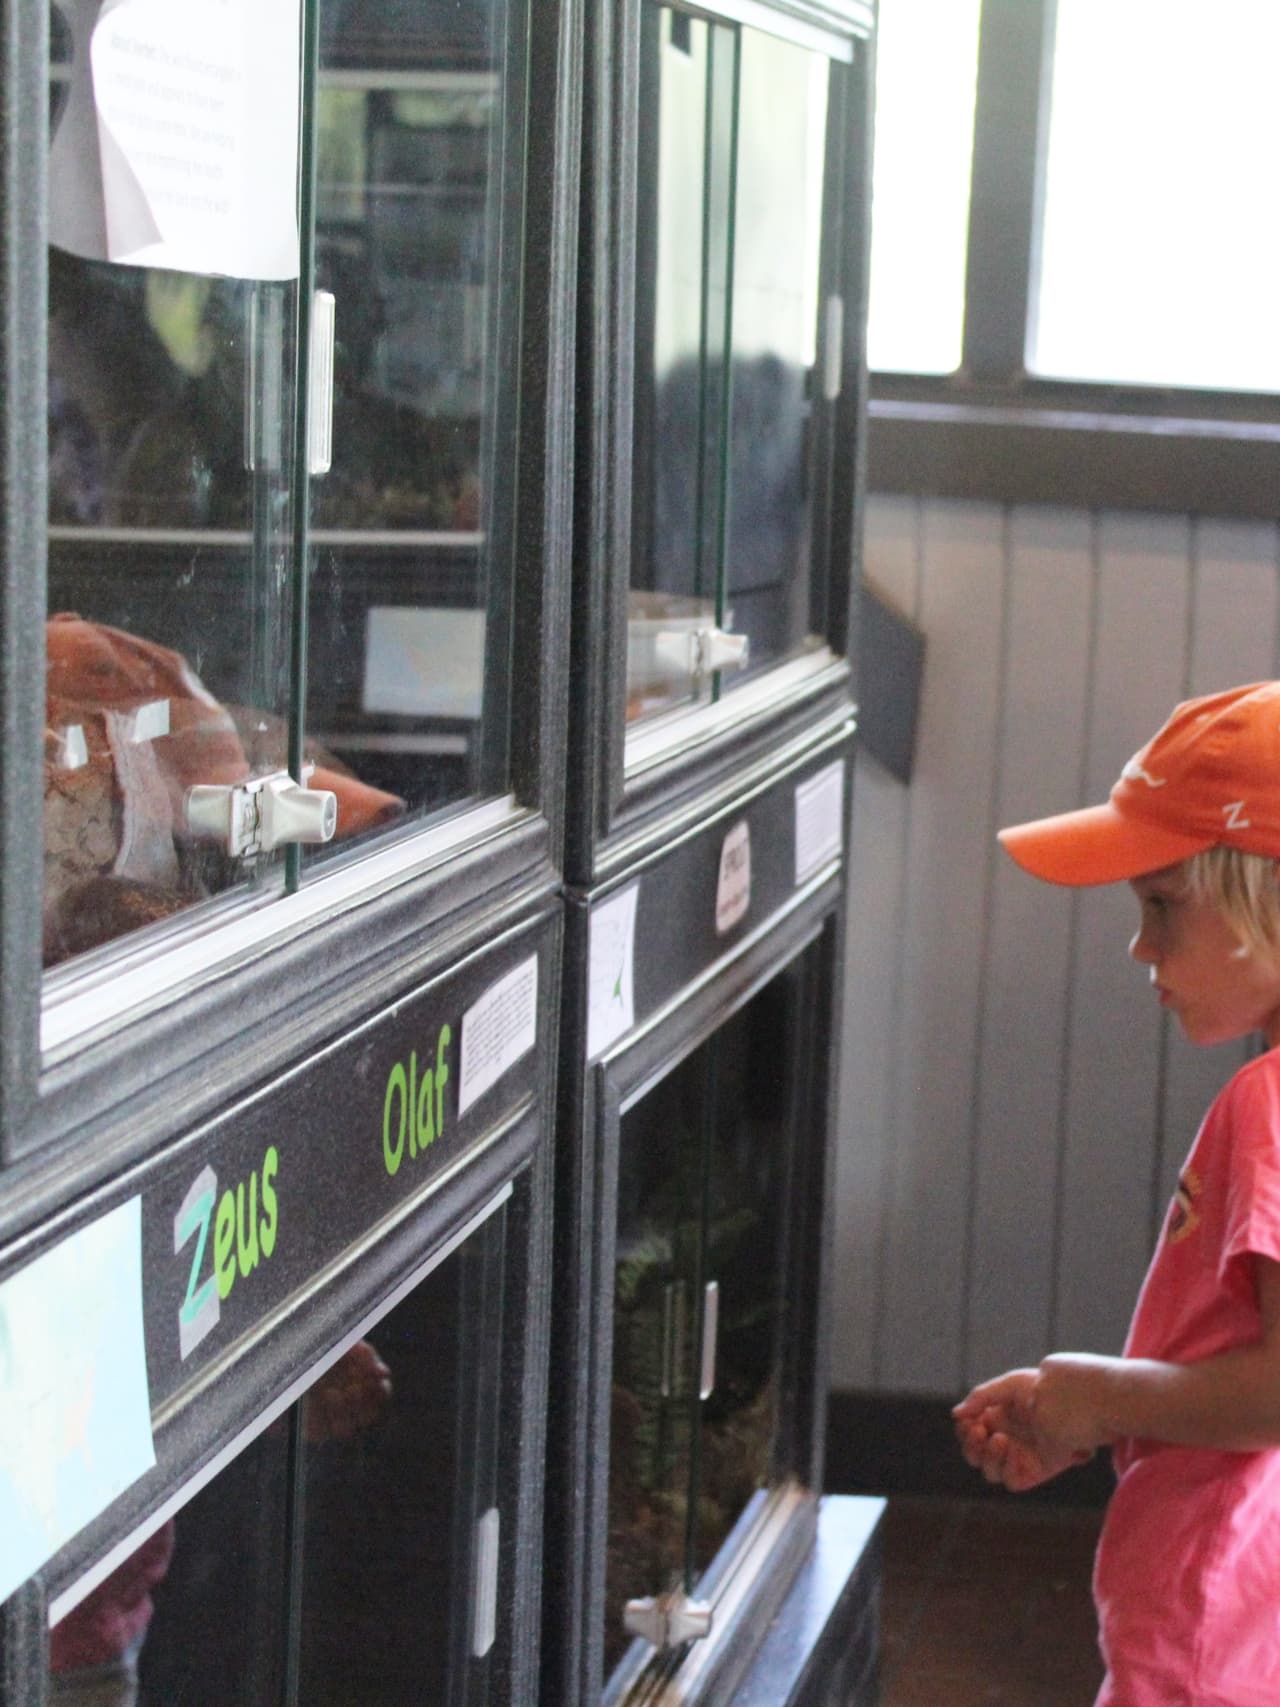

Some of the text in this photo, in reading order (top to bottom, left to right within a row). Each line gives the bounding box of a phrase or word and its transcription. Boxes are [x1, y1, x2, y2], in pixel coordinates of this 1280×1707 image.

[1222, 801, 1249, 829] Z
[383, 1024, 450, 1176] Olaf
[179, 1146, 278, 1325] Zeus
